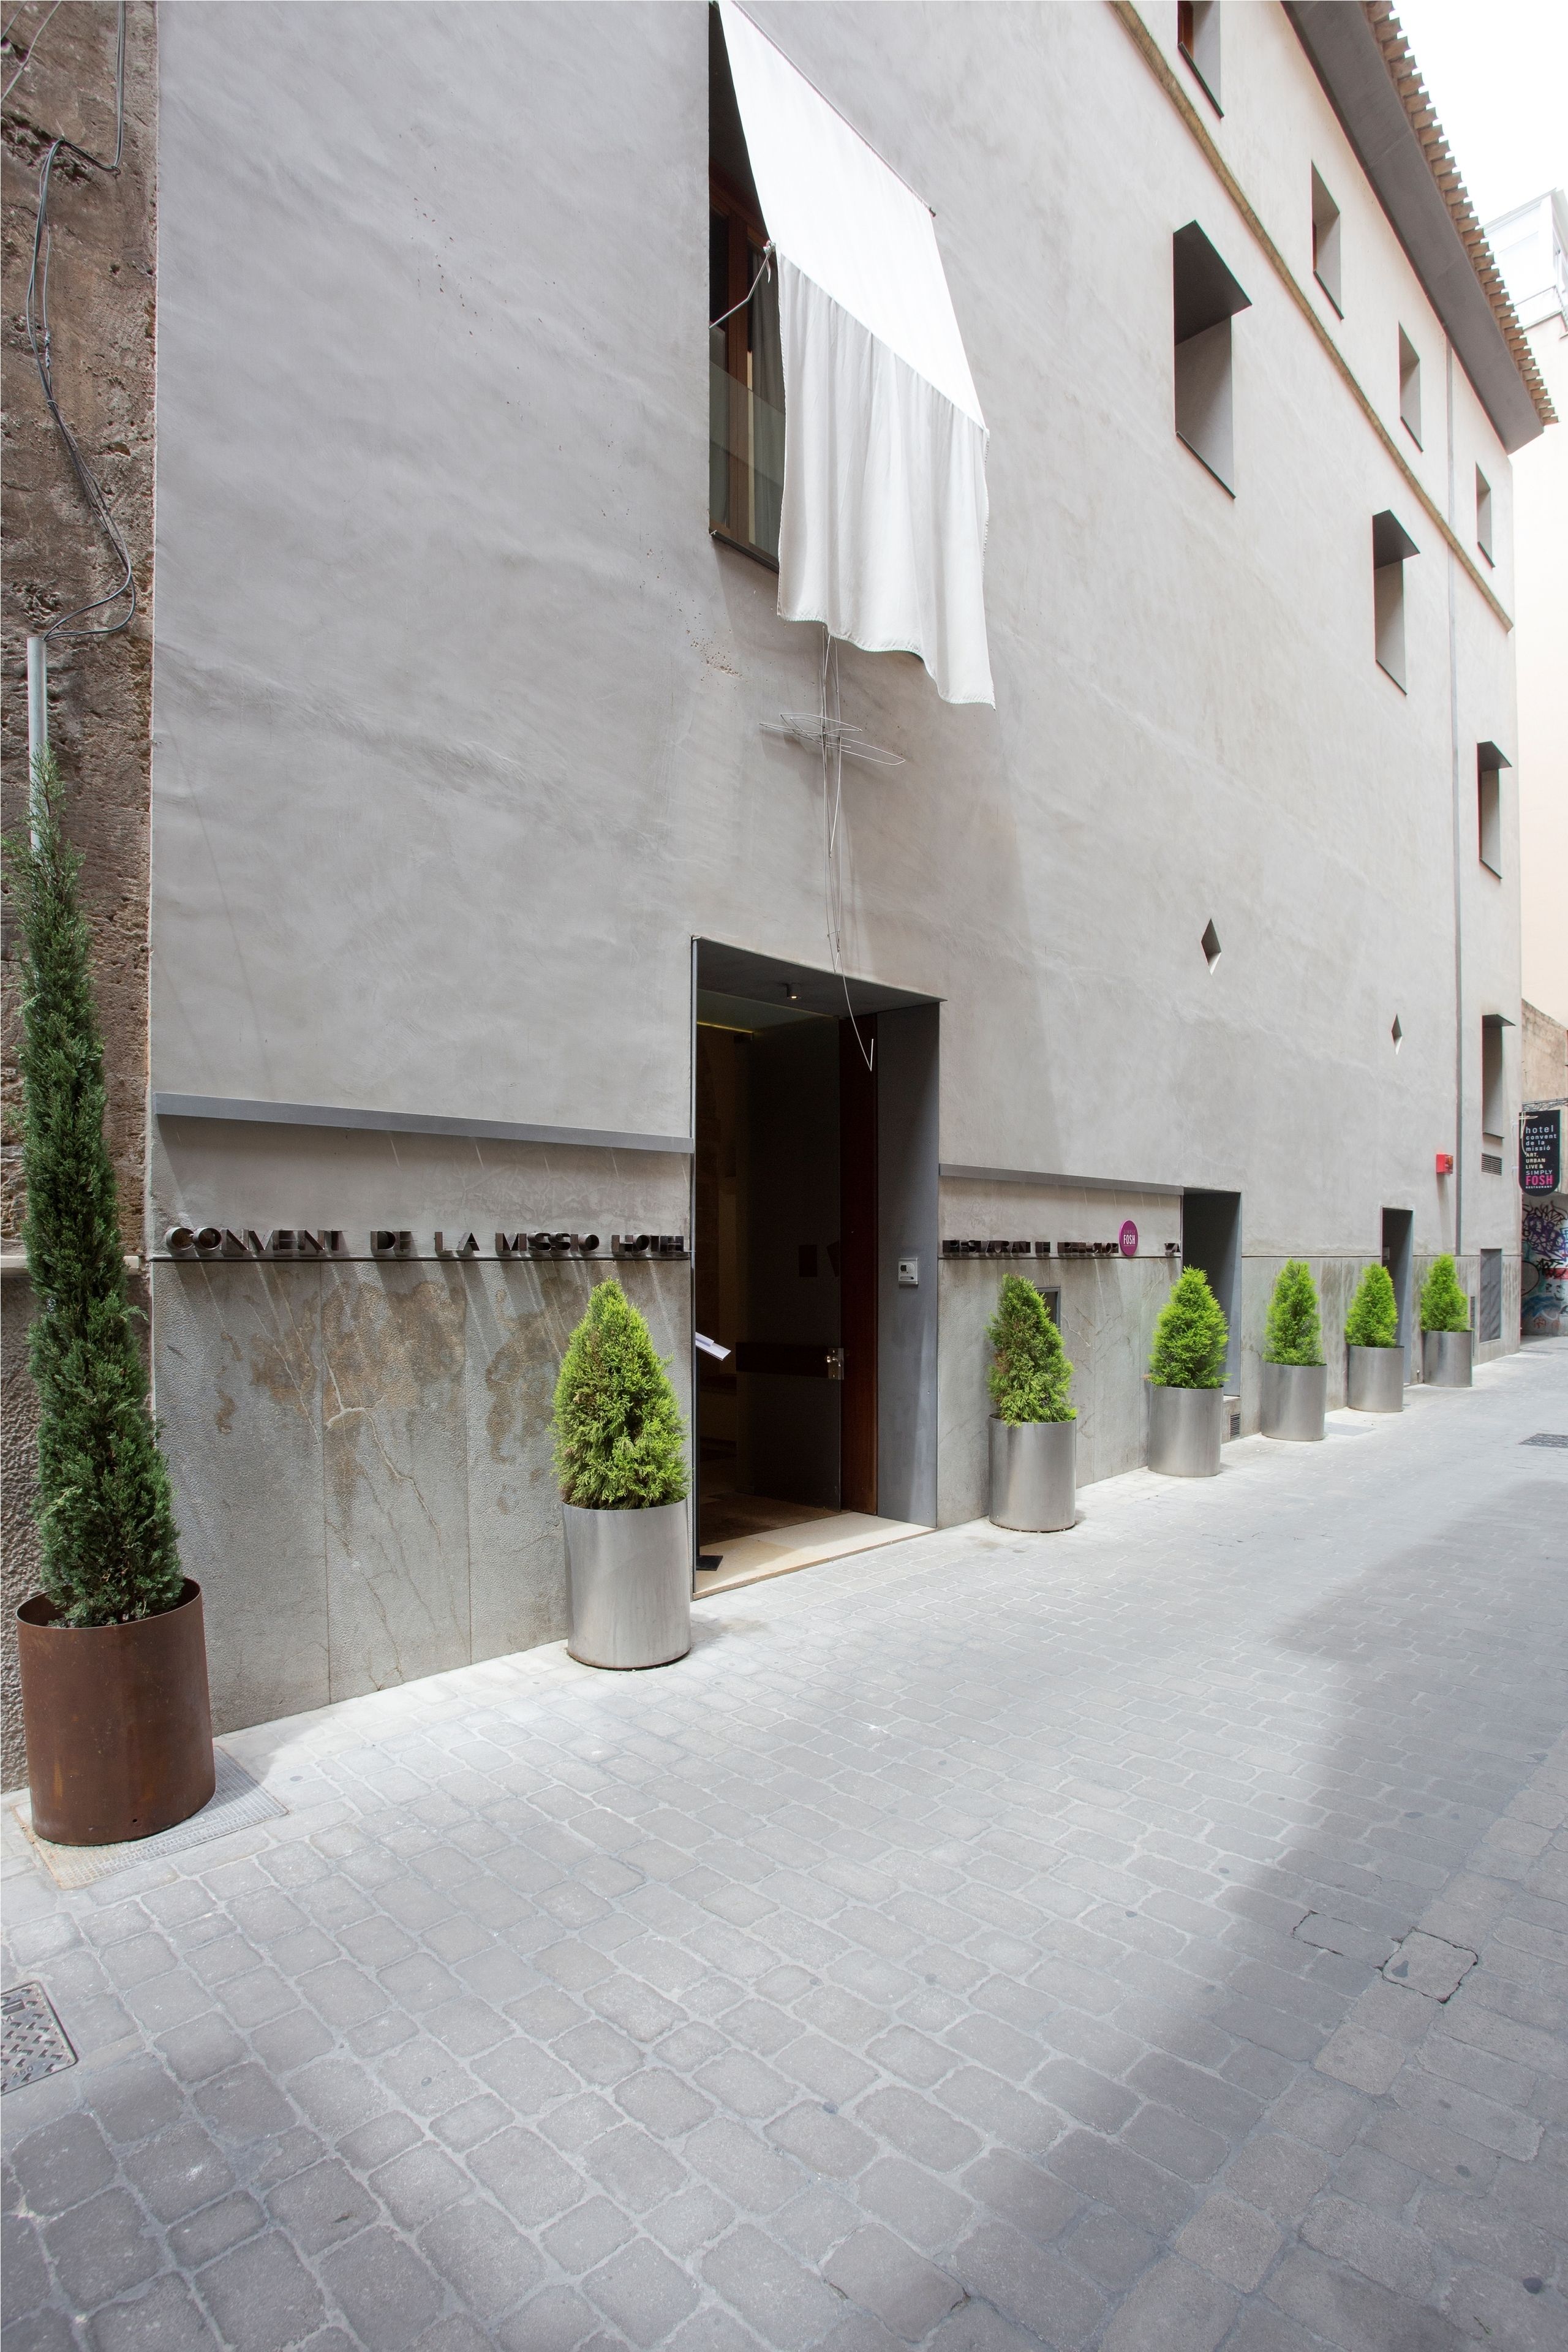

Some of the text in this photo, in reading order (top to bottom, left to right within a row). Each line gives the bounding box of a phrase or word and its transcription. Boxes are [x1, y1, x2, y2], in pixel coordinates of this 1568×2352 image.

[1526, 1125, 1553, 1133] hotel
[1526, 1175, 1553, 1185] FOSH
[166, 1227, 348, 1251] CONVENT
[371, 1230, 417, 1251] DE
[435, 1232, 480, 1251] LA
[611, 1234, 696, 1252] HOTEL
[1123, 1235, 1136, 1245] FOSH
